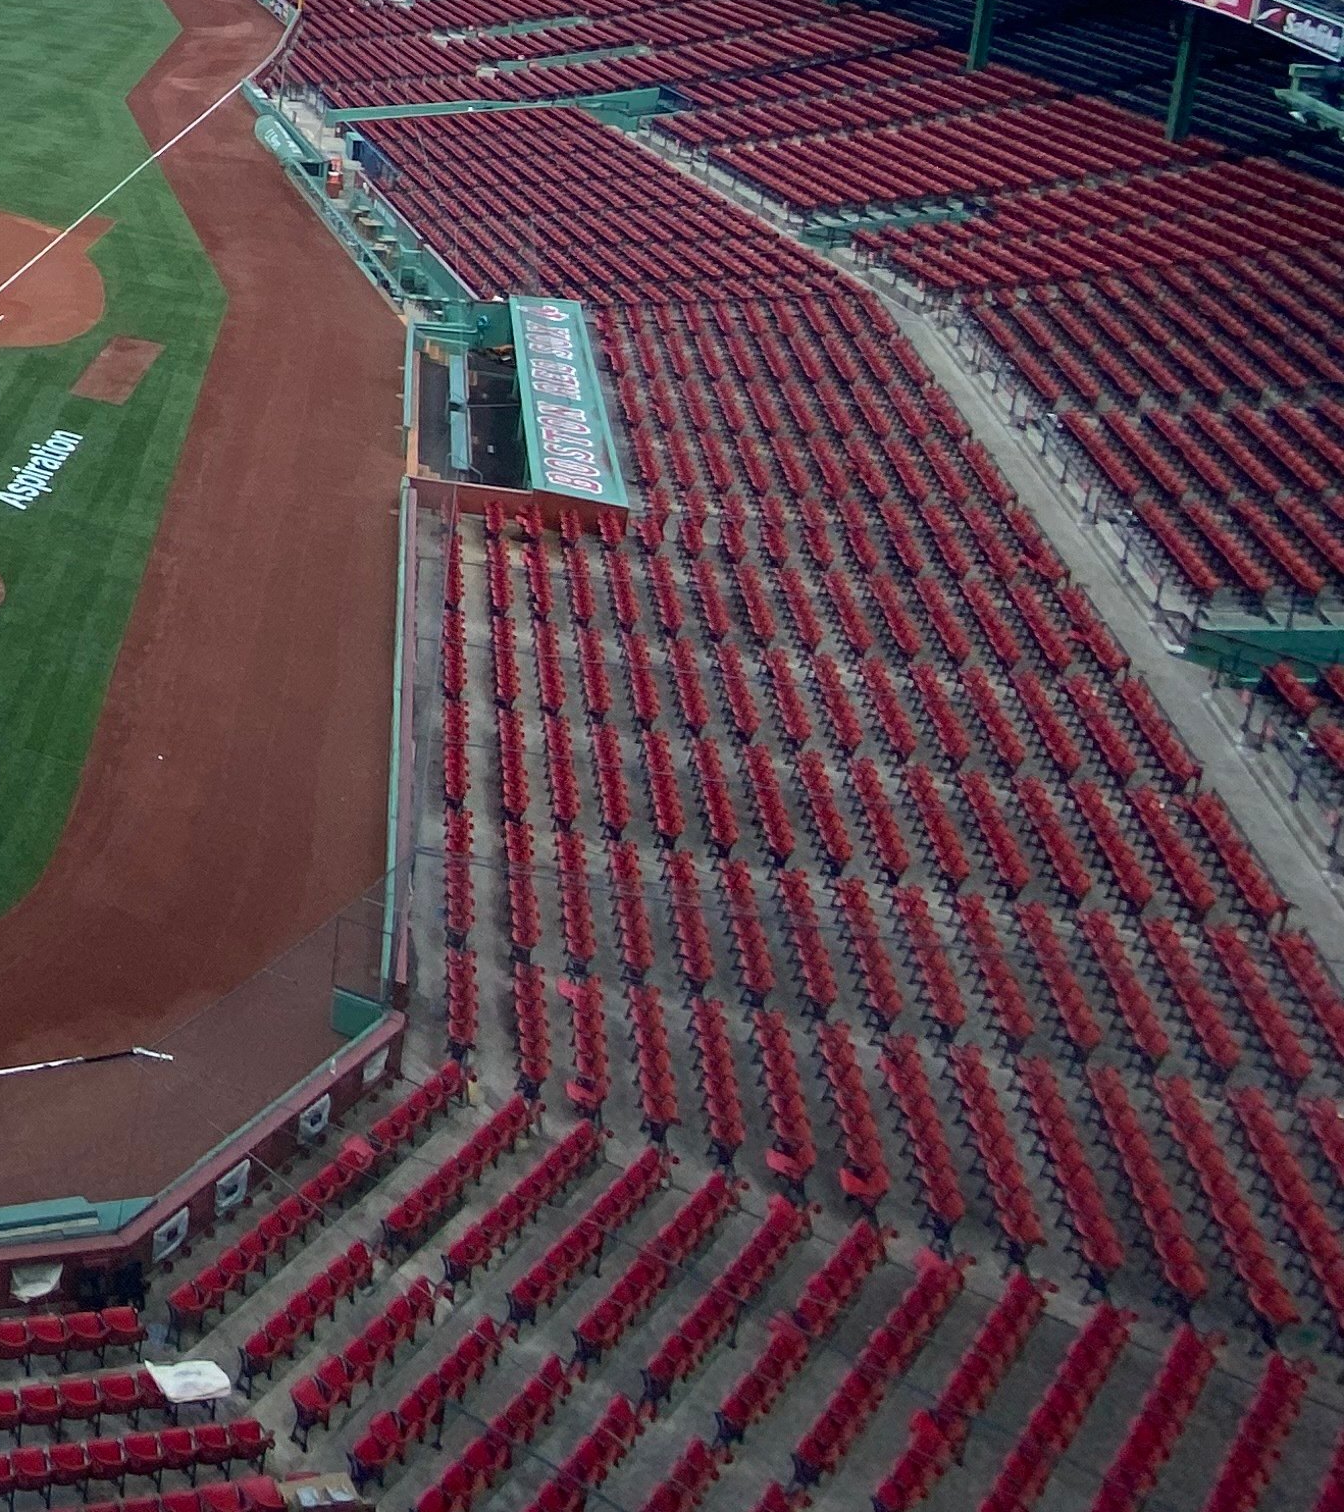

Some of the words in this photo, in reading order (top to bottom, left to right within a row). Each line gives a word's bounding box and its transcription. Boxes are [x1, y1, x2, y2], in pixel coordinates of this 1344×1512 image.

[525, 319, 574, 360] SOX
[531, 359, 581, 401] RED
[537, 401, 603, 494] BOSTON
